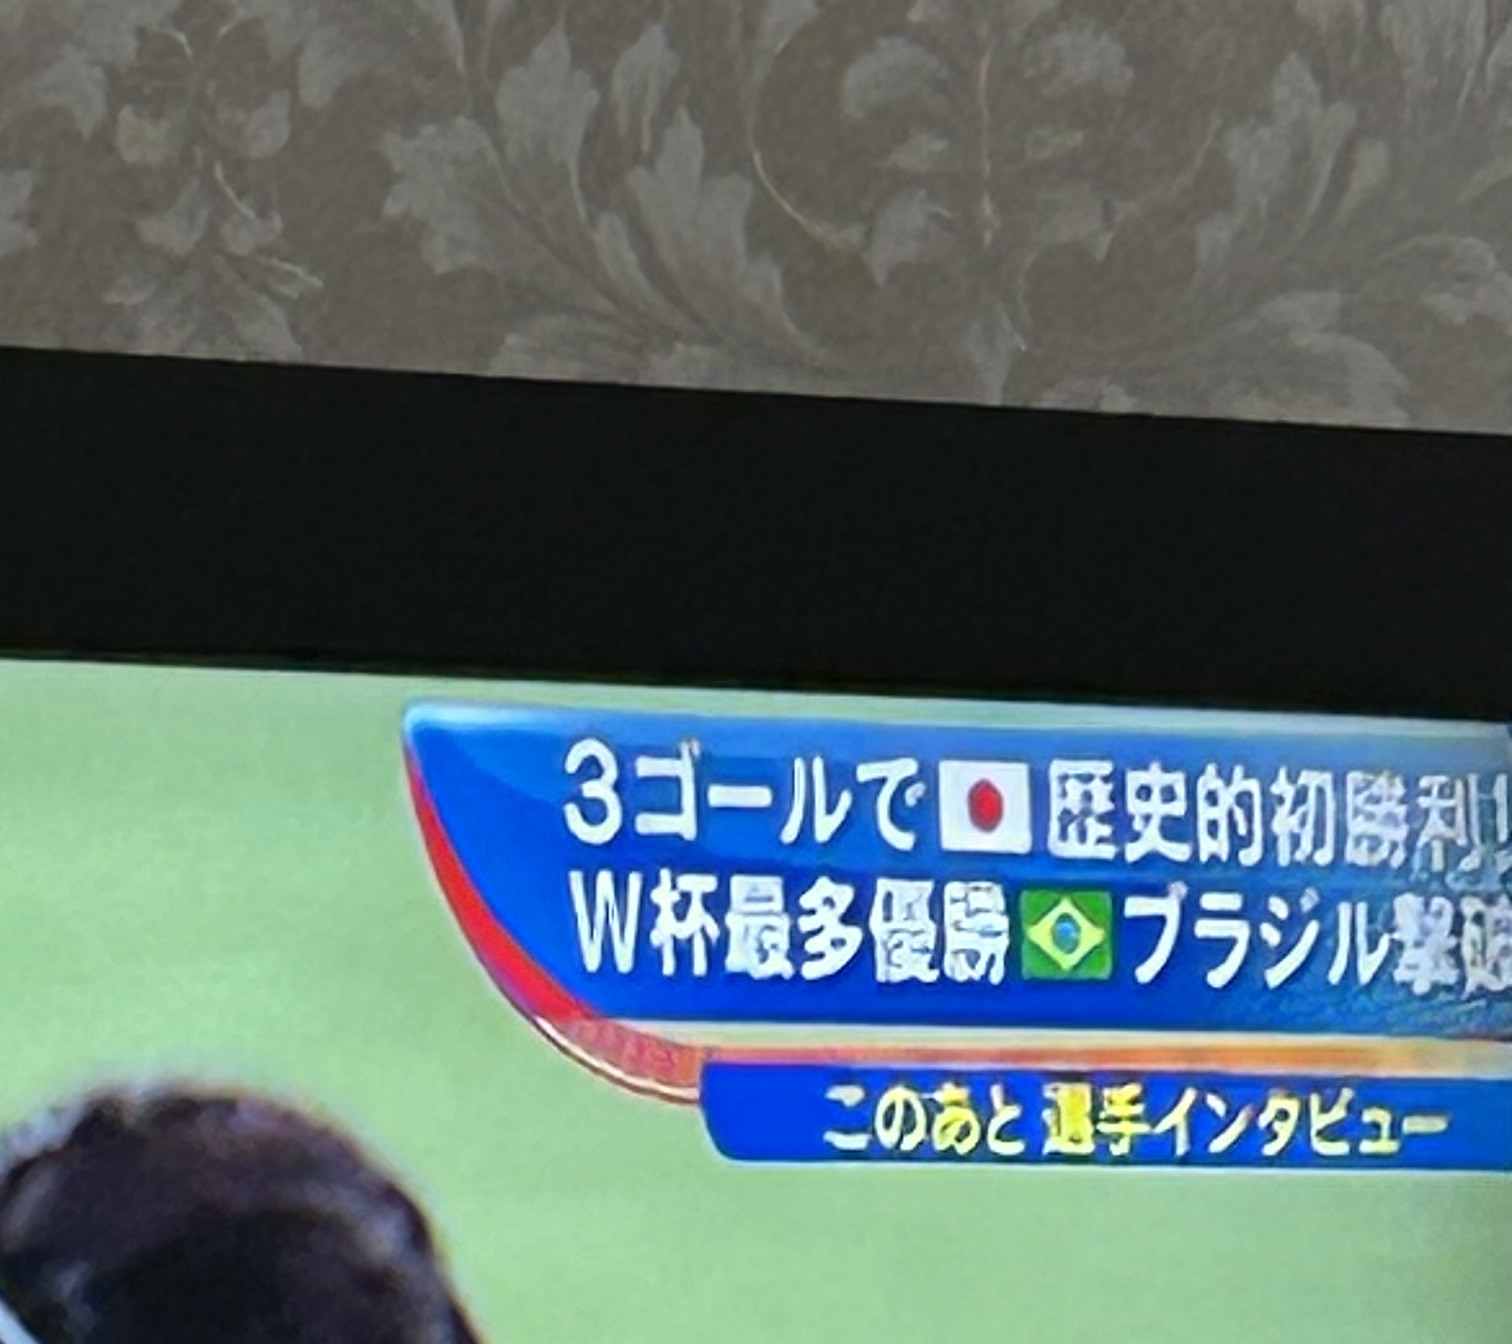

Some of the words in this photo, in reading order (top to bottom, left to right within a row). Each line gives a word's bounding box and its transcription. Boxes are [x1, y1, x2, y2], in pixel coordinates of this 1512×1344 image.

[564, 738, 926, 851] 3ゴールで
[569, 868, 1010, 986] W杯最多優勝
[823, 1082, 1025, 1156] このあと
[1041, 1082, 1448, 1156] 選手インタビュー
